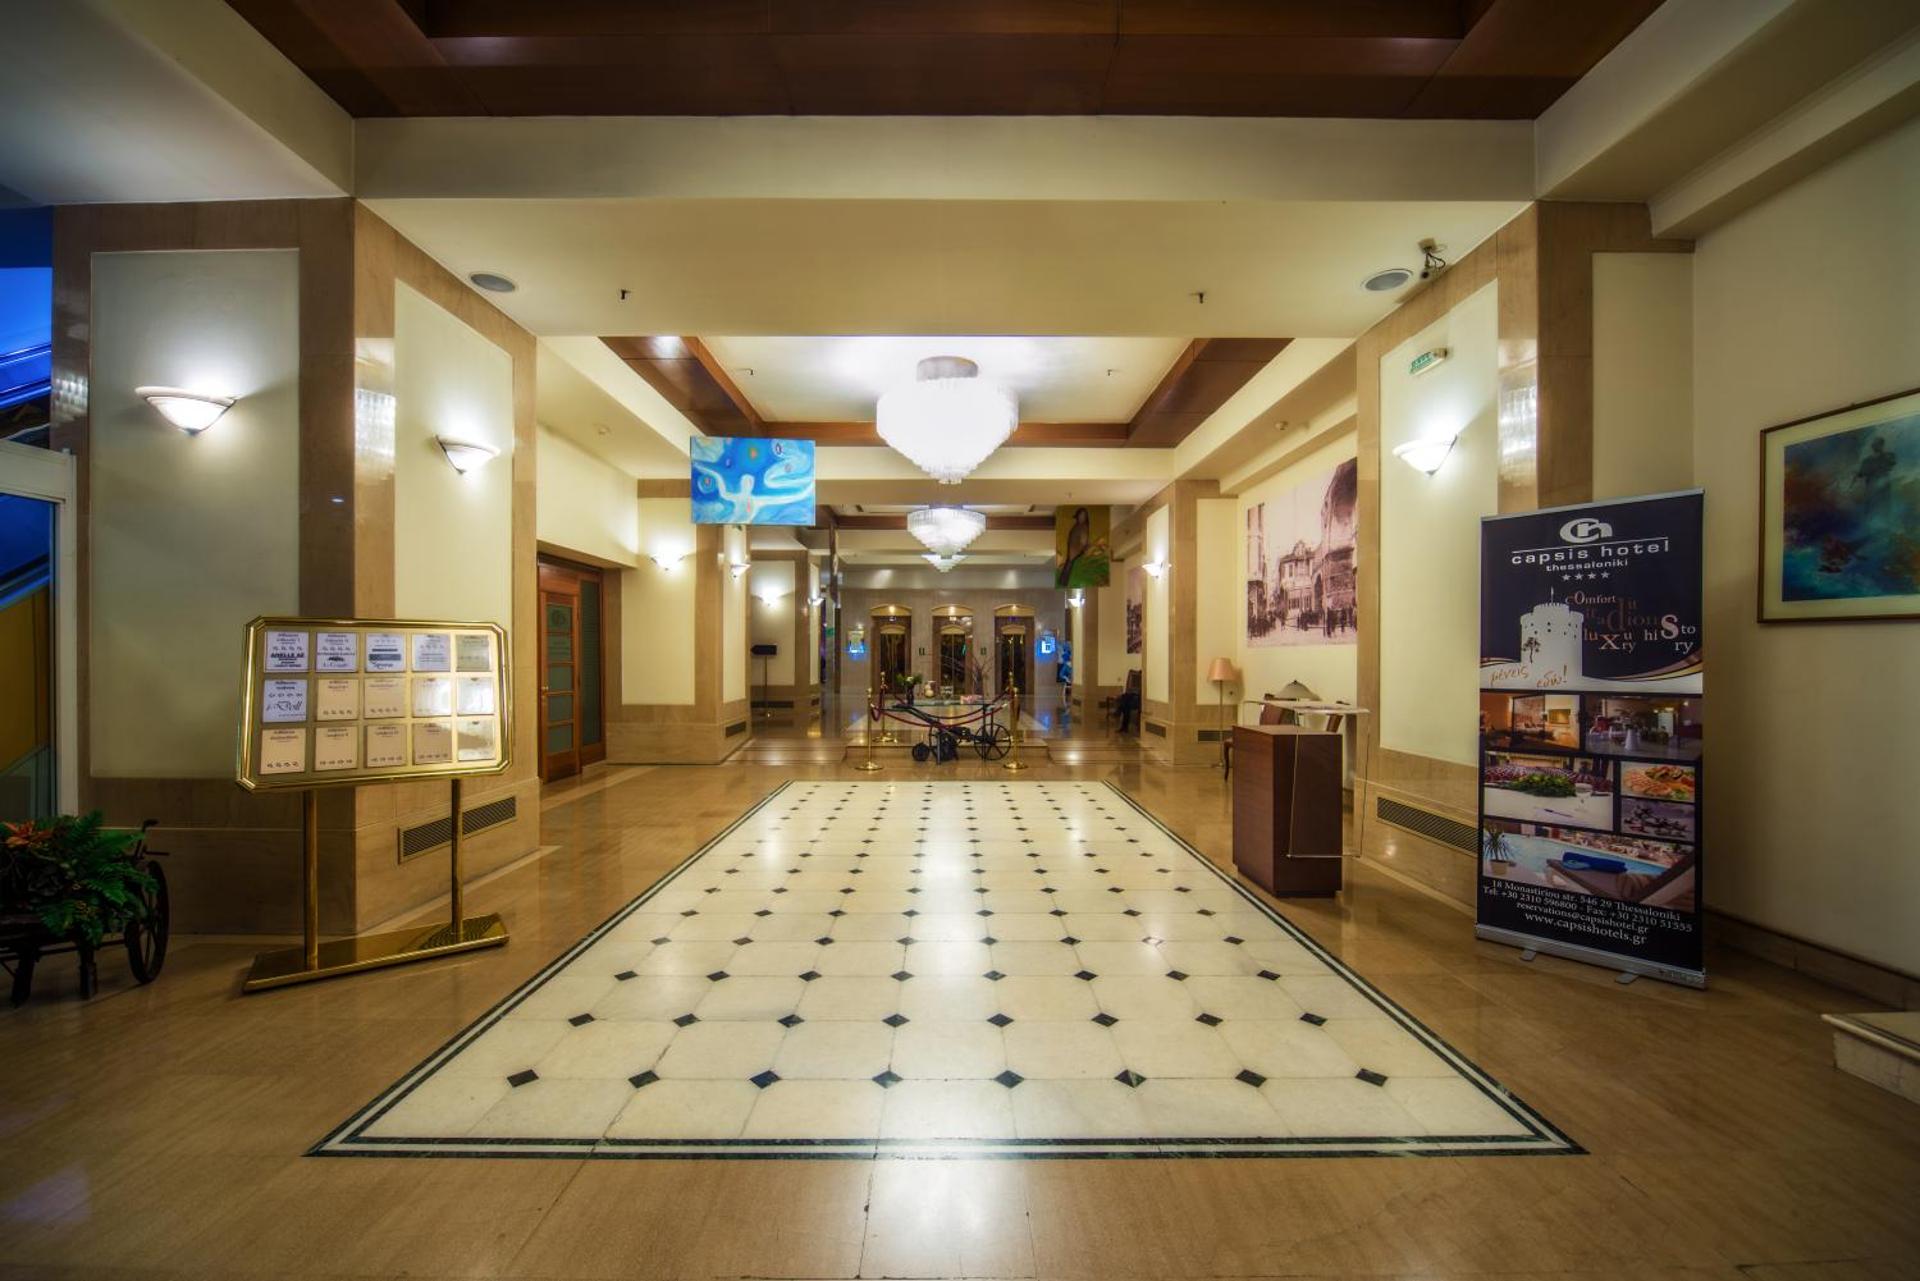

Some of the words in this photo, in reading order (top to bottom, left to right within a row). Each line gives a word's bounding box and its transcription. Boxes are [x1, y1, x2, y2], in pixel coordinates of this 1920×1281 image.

[1511, 547, 1589, 566] capsis
[1601, 540, 1669, 558] hotel
[1545, 559, 1629, 572] thessaloniki
[1492, 879, 1503, 888] 18
[1562, 892, 1577, 902] str.
[1614, 900, 1681, 921] Thessaloniki
[1501, 889, 1518, 900] +30
[1524, 912, 1648, 946] www.capsishotels.gr
